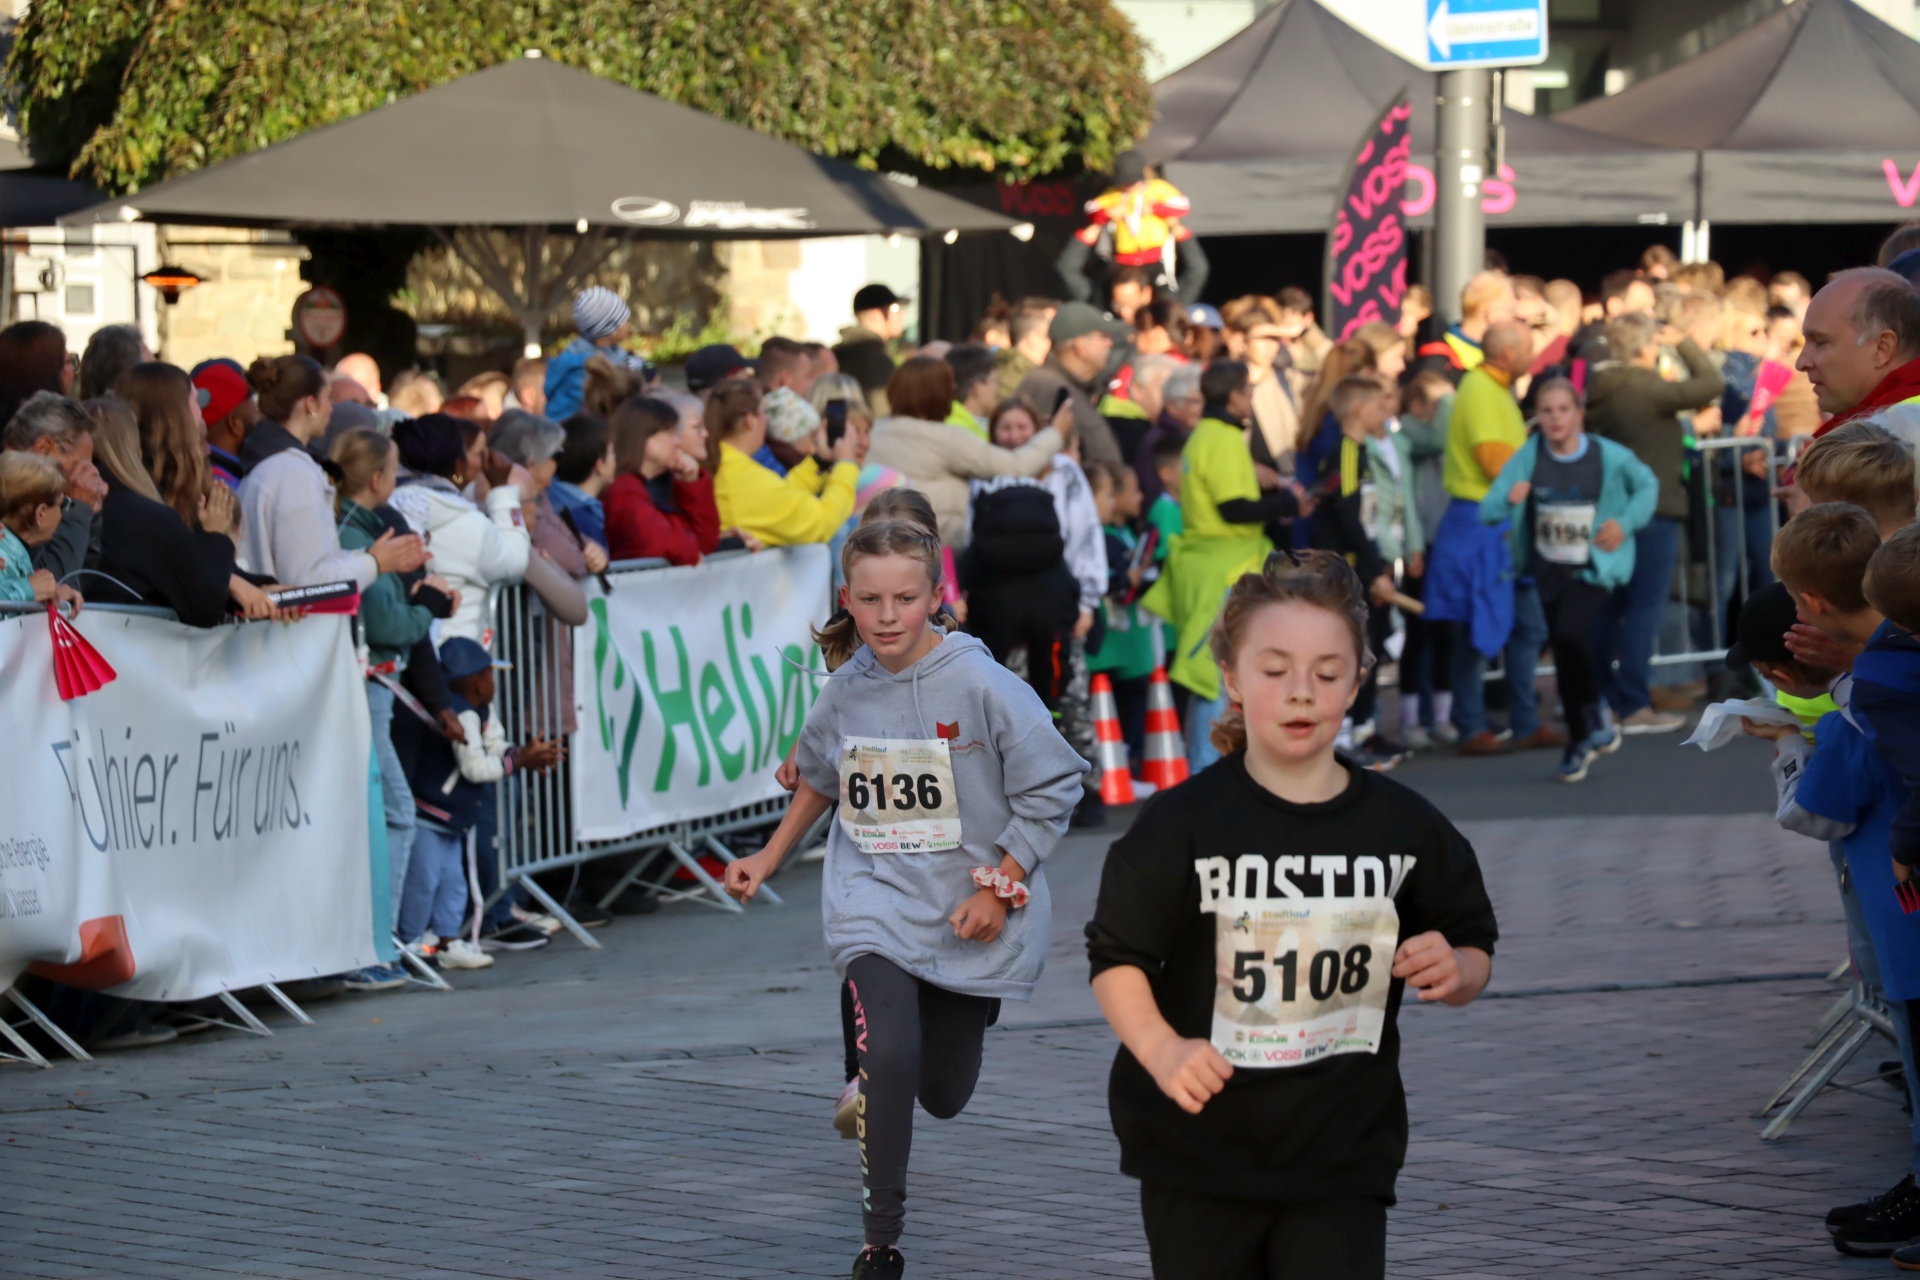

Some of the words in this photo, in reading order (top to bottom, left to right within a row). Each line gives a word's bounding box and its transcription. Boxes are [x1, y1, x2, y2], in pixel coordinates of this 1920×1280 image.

[1330, 213, 1403, 306] VOSS
[861, 745, 888, 753] Stadtlauf
[100, 726, 178, 851] hier.
[192, 720, 252, 843] Für
[253, 739, 312, 835] uns.
[848, 772, 943, 811] 6136
[871, 842, 899, 850] VOSS
[900, 842, 921, 850] BEW
[933, 840, 956, 848] Helios
[1261, 909, 1310, 919] Stadtlauf
[1232, 944, 1372, 1004] 5108
[1264, 1049, 1302, 1062] VOSS
[1304, 1043, 1328, 1059] BEW
